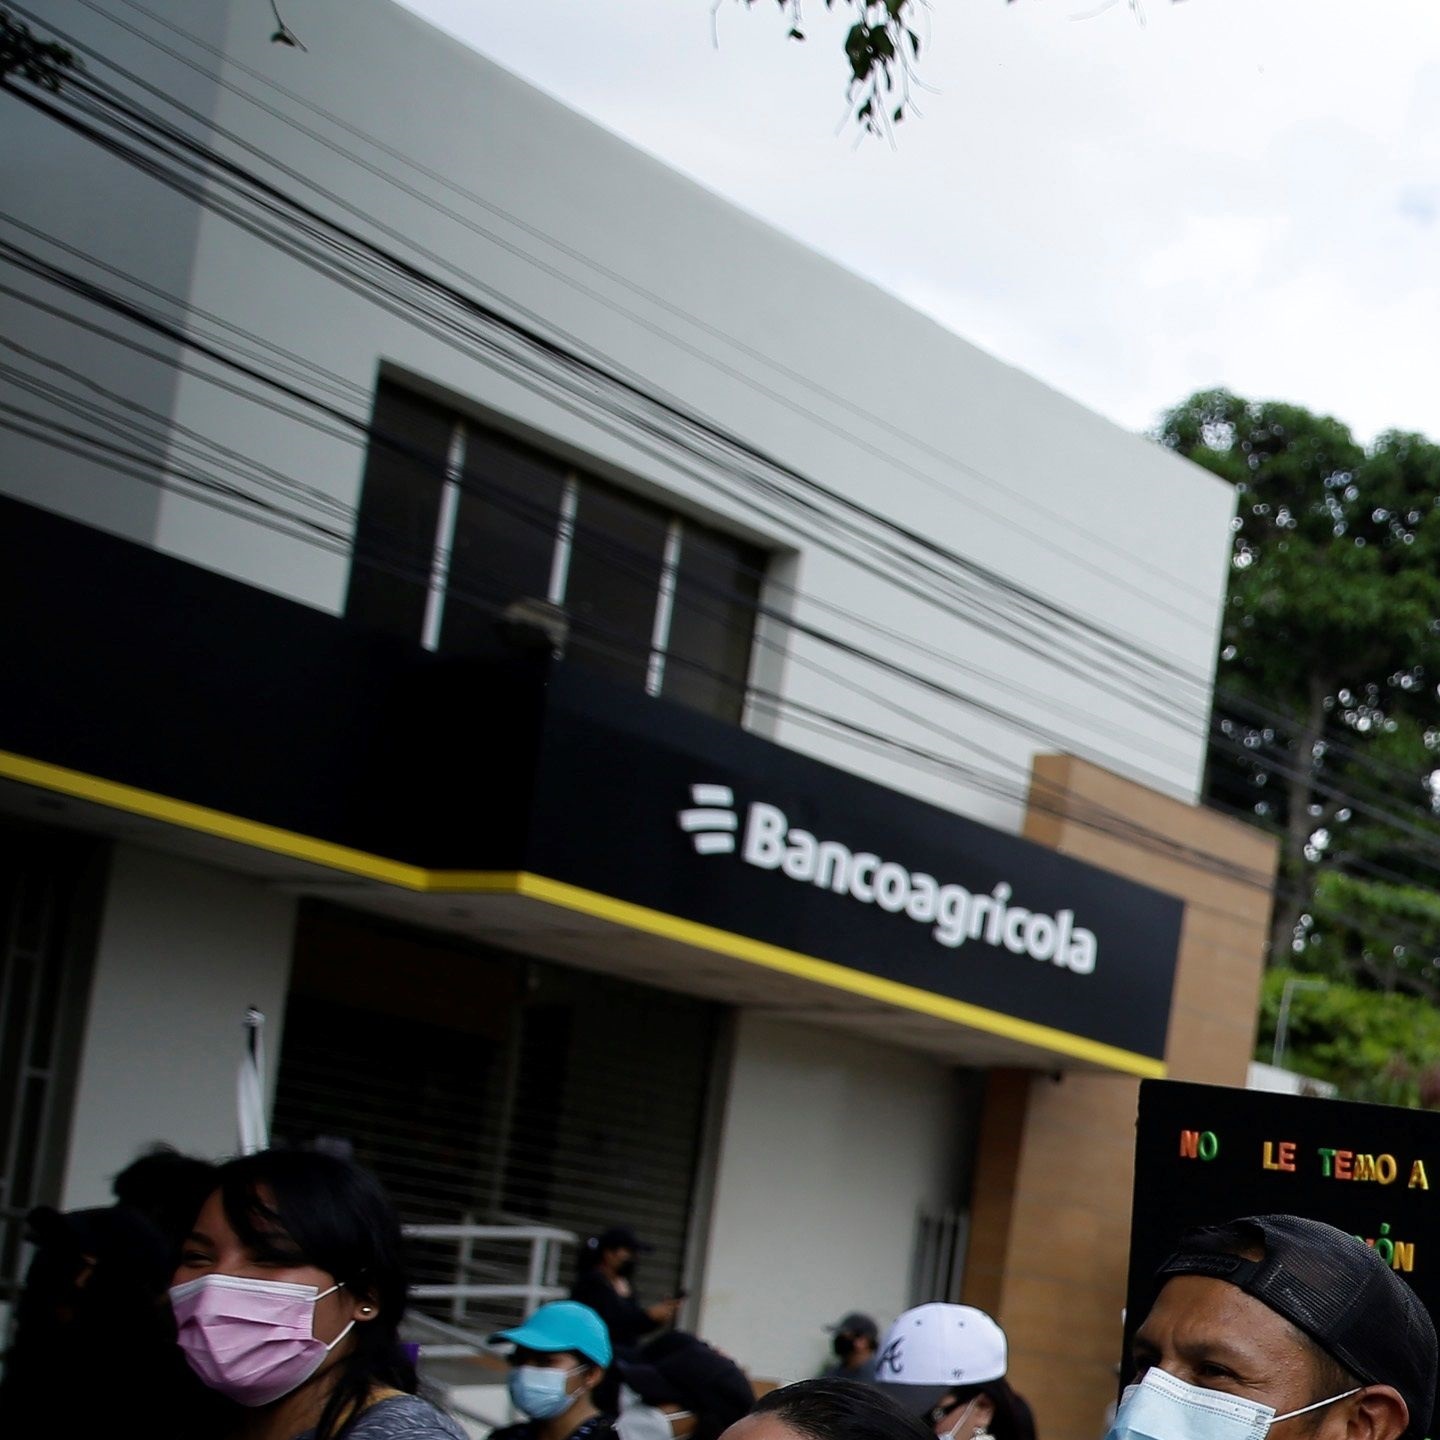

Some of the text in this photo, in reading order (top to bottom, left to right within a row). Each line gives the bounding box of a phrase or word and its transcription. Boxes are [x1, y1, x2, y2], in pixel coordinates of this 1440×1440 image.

[742, 800, 1098, 975] Bancoagrícola
[1179, 1129, 1220, 1163] NO
[1262, 1140, 1297, 1173] LE
[1317, 1146, 1399, 1186] TEMO
[1407, 1159, 1430, 1191] A
[1353, 1221, 1416, 1273] ÓN
